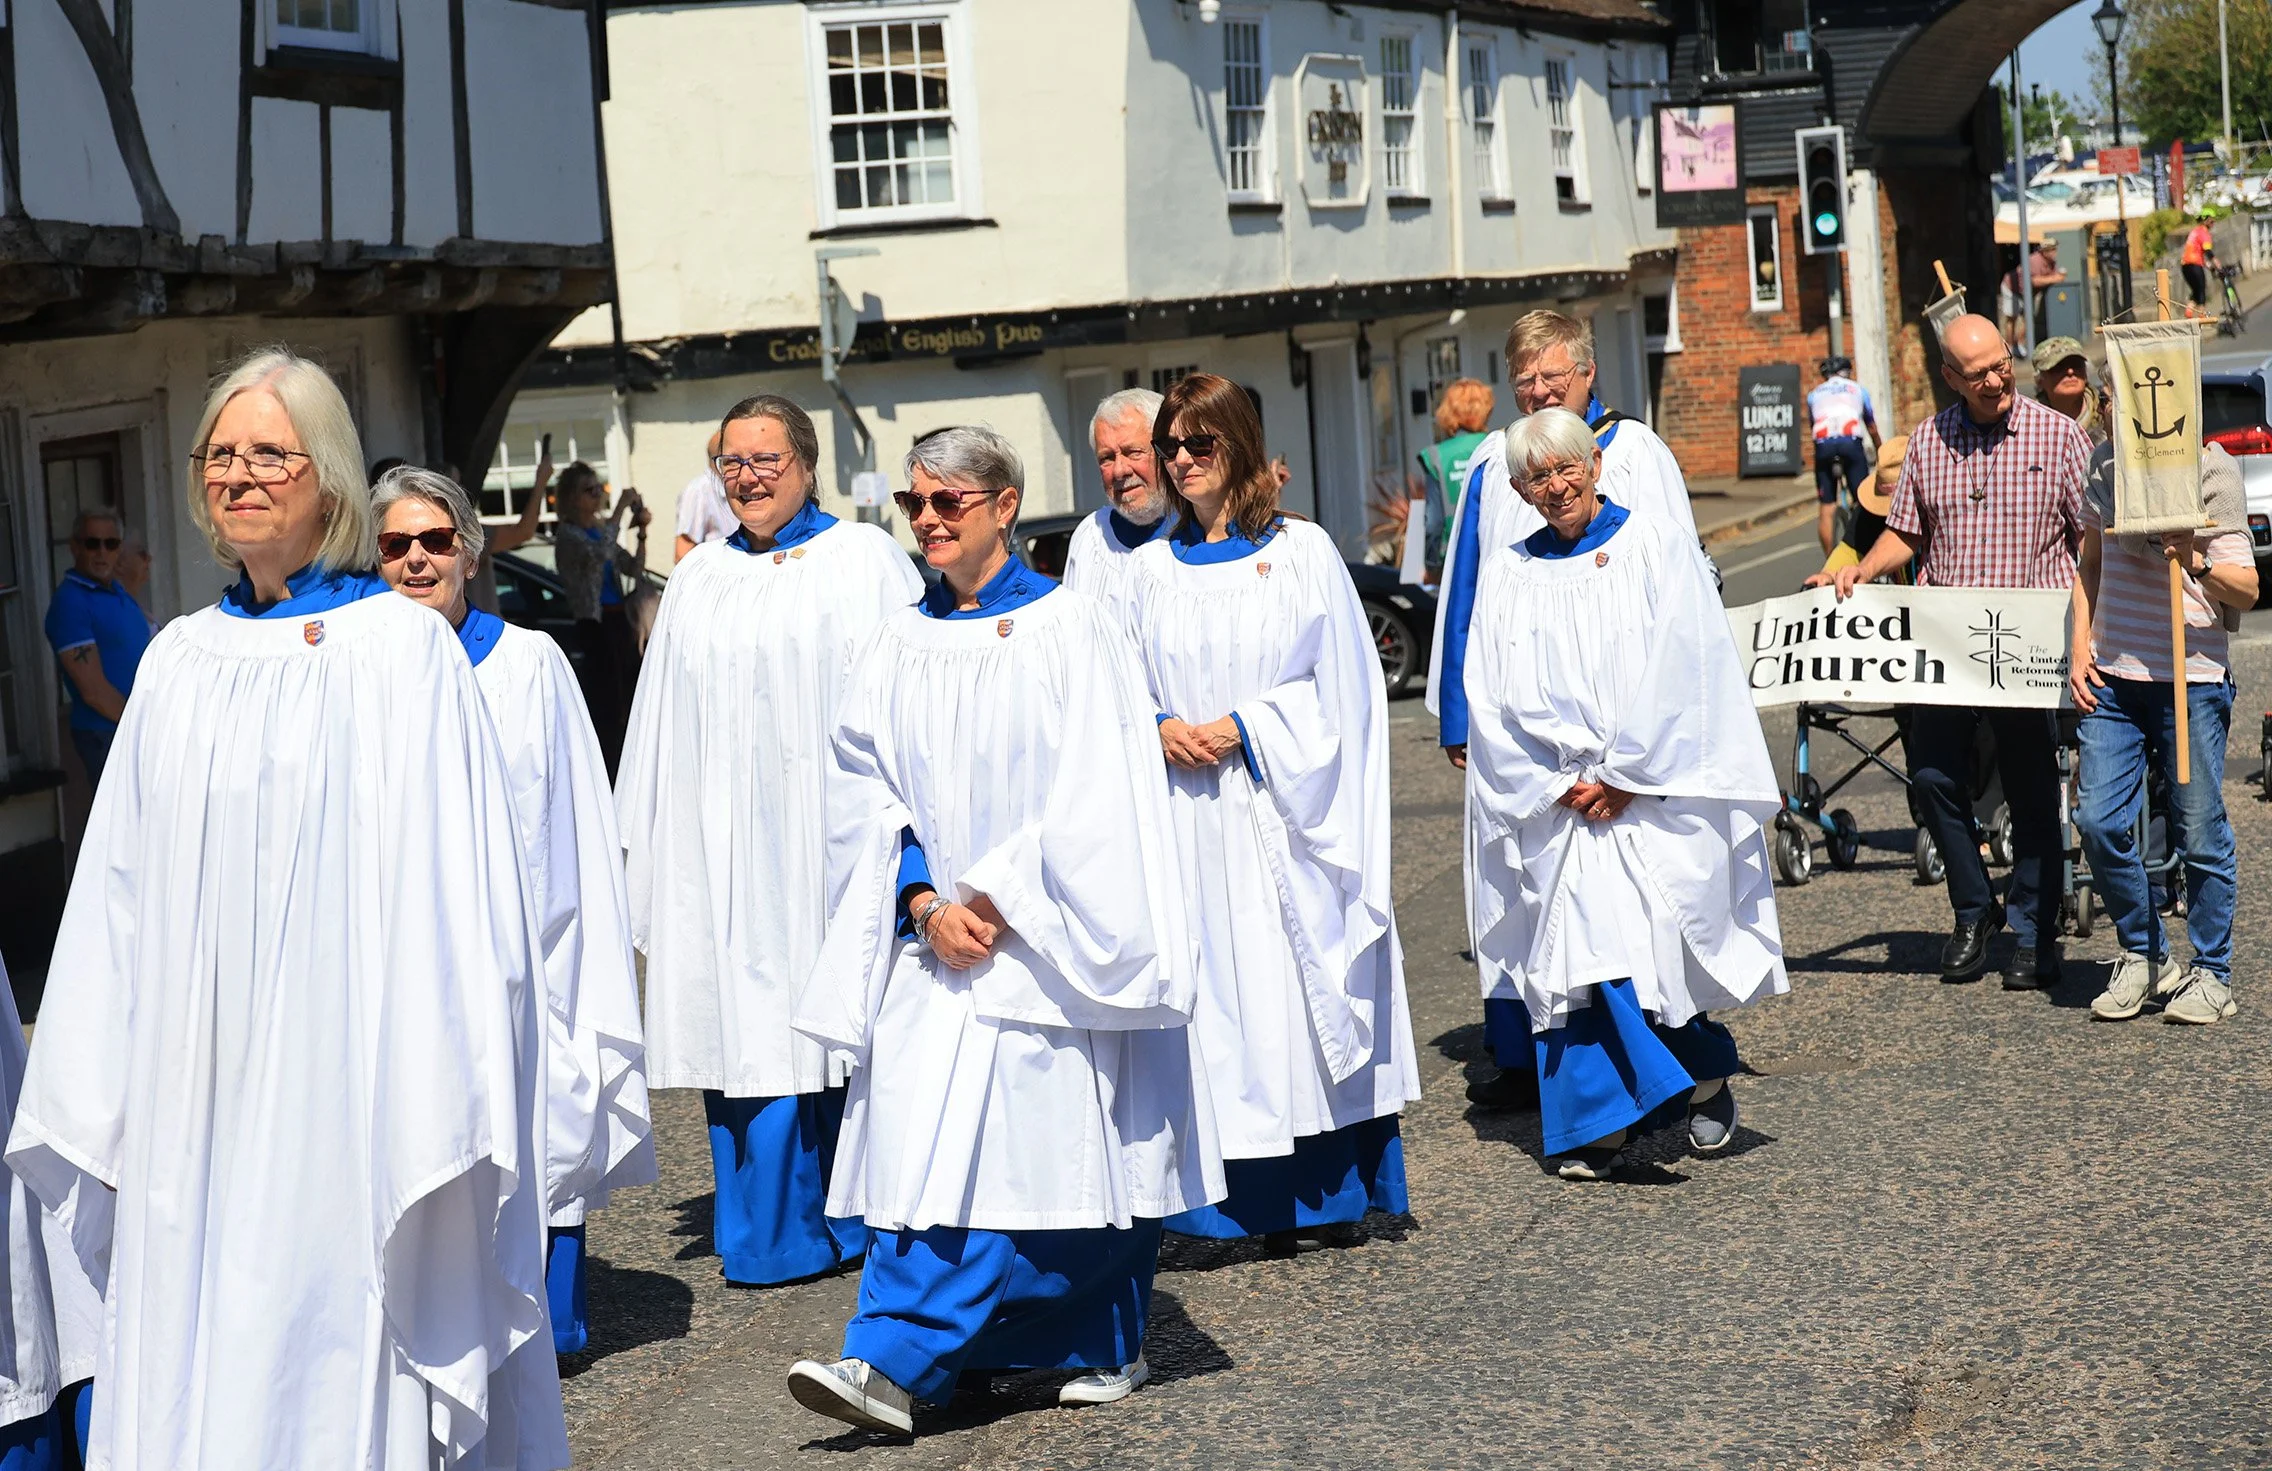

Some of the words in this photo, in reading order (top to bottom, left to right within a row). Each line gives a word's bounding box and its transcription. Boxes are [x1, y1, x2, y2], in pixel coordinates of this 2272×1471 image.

[902, 328, 985, 354] English
[995, 323, 1042, 349] Pub
[1743, 404, 1793, 429] LUNCH
[2146, 446, 2185, 459] Clement
[1753, 606, 1913, 651] United
[2028, 645, 2048, 654] The
[2030, 656, 2068, 665] United
[1749, 649, 1946, 689] Church
[2011, 666, 2068, 675] Reformed
[2026, 679, 2068, 688] Church
